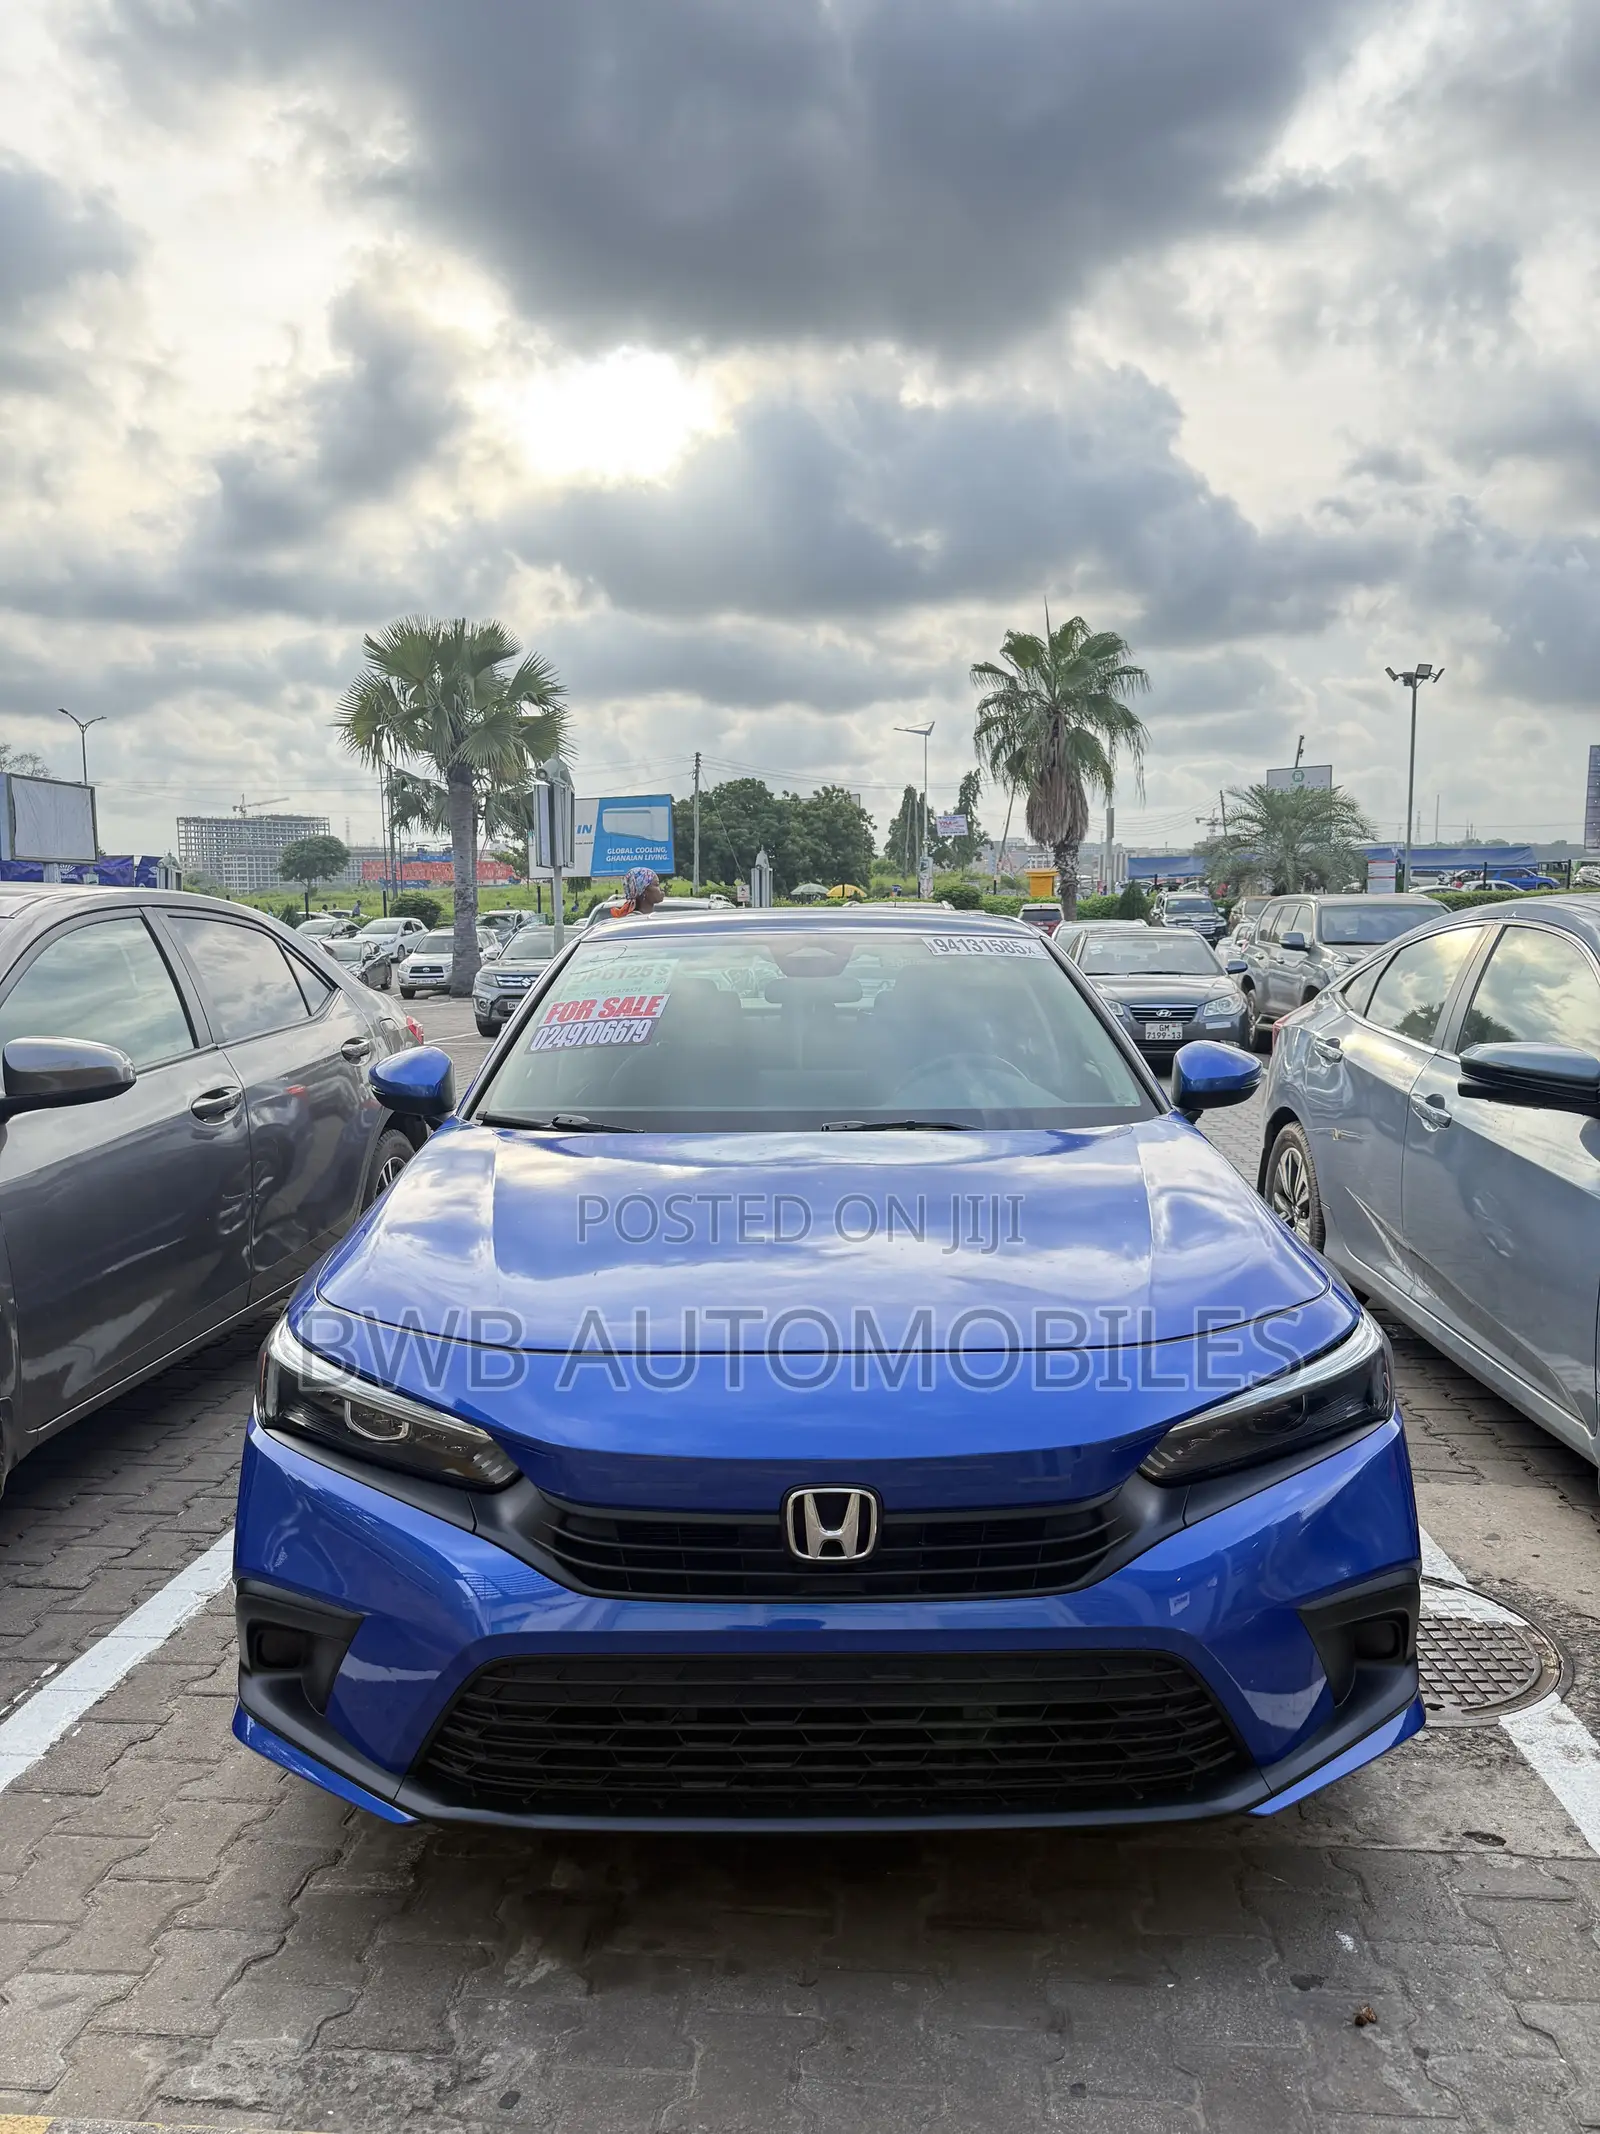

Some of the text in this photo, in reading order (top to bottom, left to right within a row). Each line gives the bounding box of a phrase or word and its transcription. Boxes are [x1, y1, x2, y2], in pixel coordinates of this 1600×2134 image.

[607, 847, 633, 855] GLOBAL
[544, 995, 664, 1025] FOR SALE
[530, 1019, 652, 1051] 0249706679
[1160, 1024, 1170, 1032] GM
